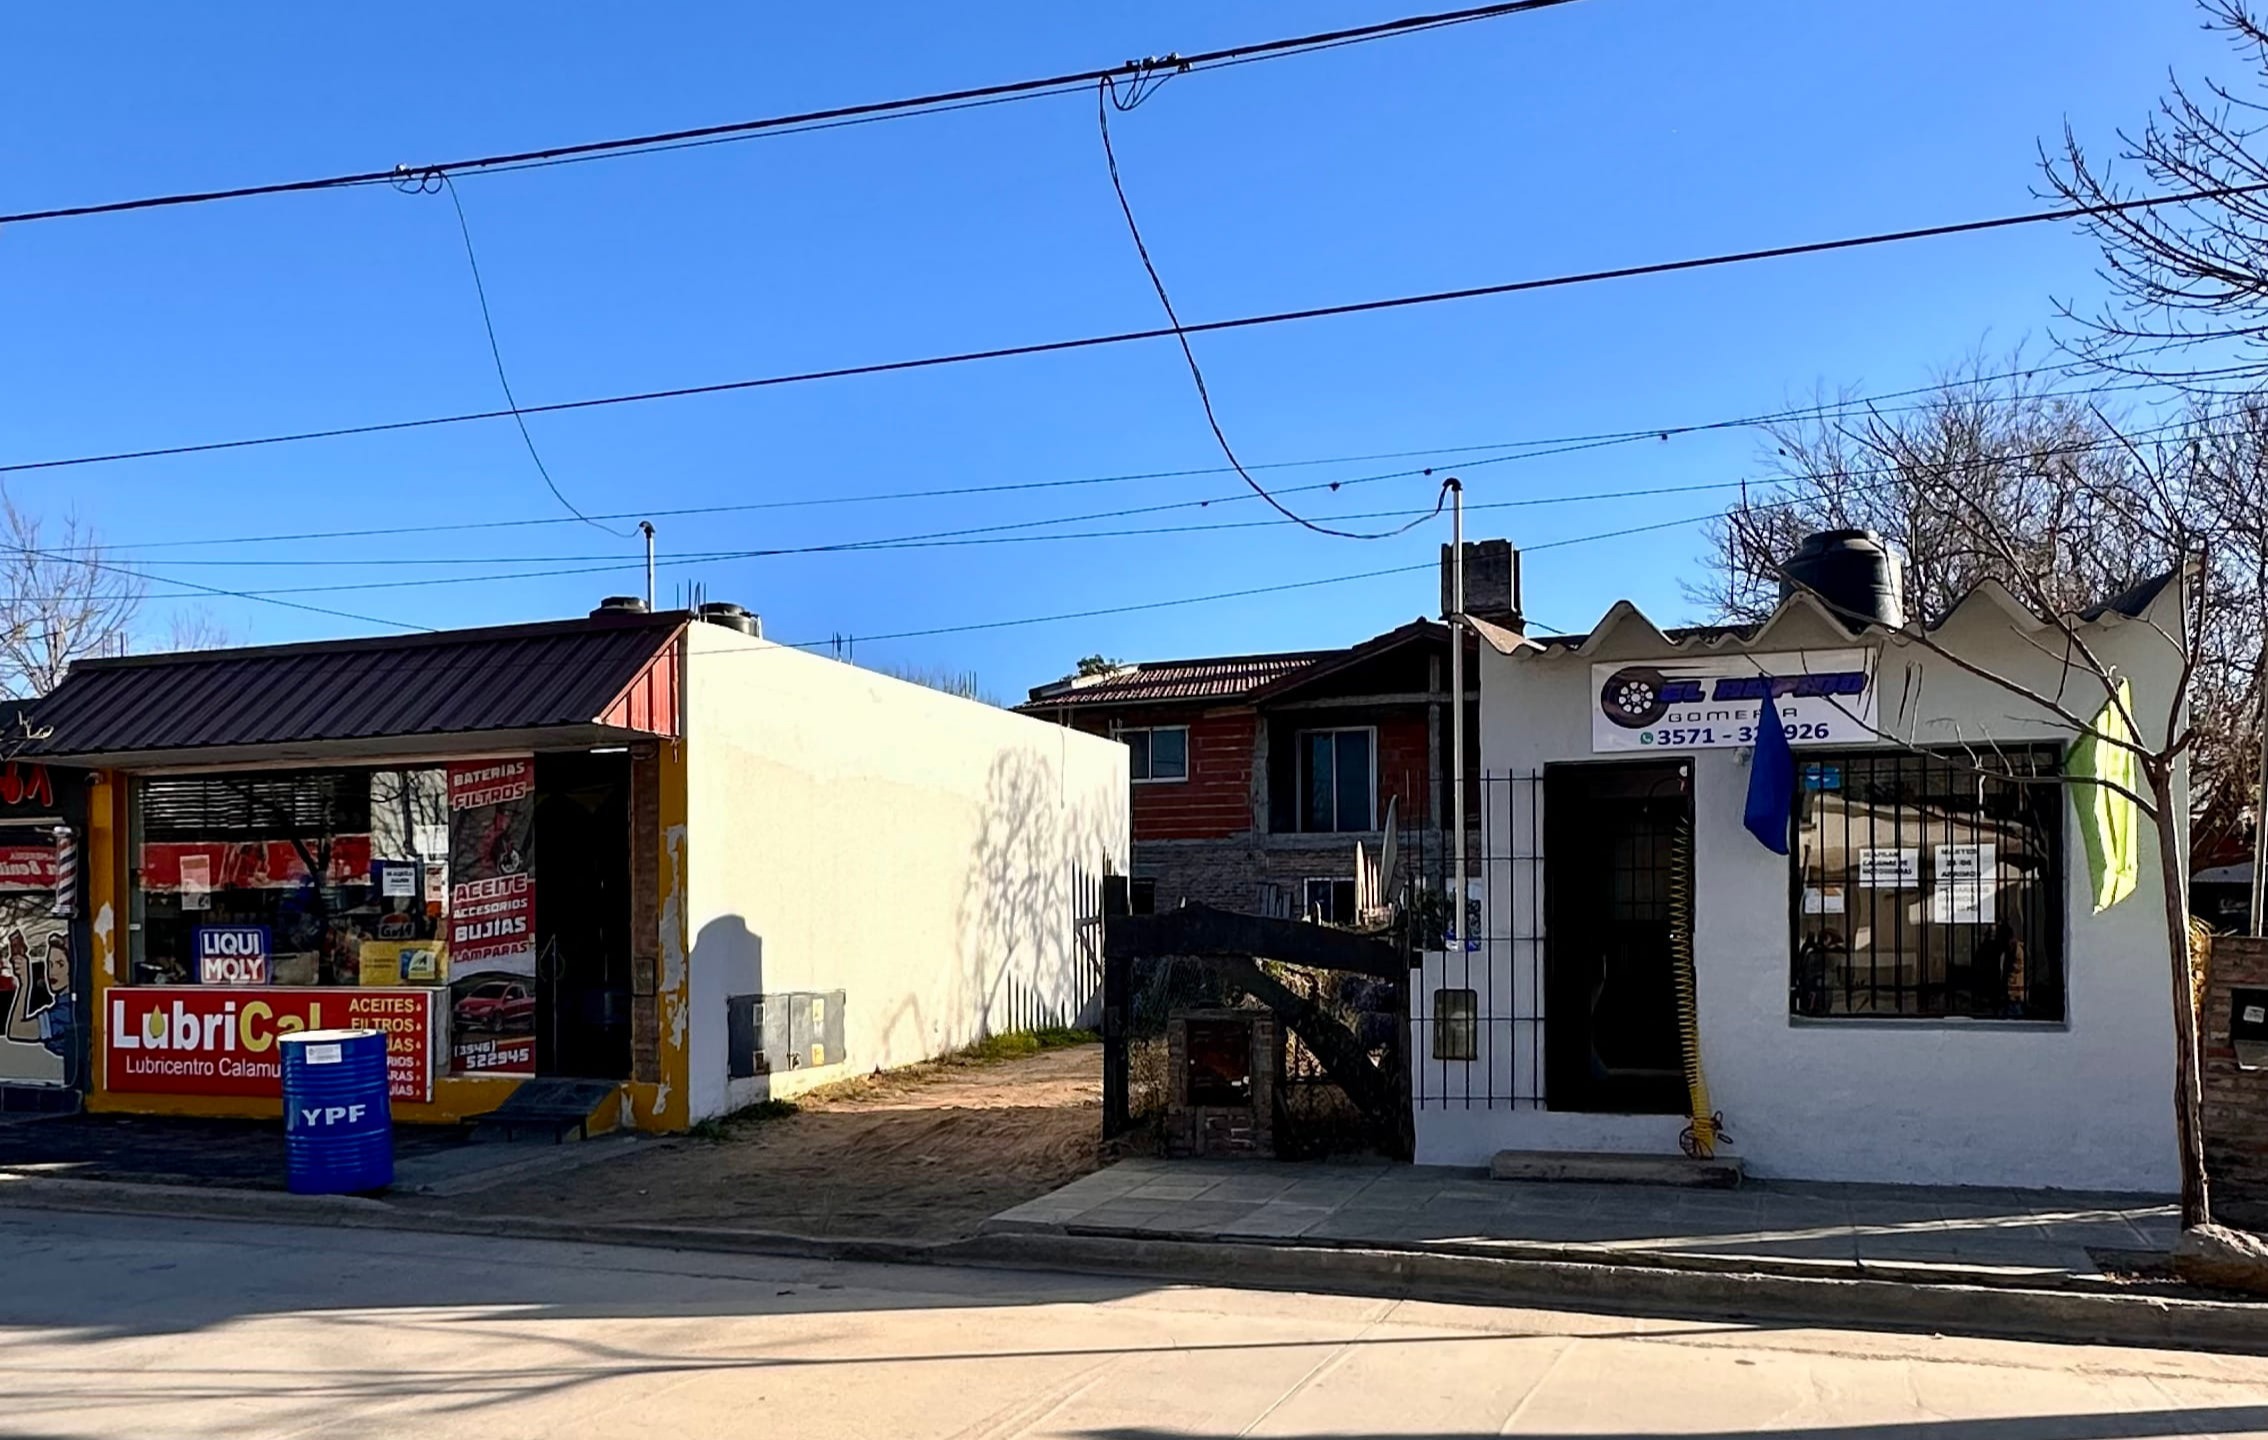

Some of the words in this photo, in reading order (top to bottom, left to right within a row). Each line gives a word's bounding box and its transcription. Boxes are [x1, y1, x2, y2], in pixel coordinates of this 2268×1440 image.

[1656, 680, 1706, 703] EL
[1668, 707, 1798, 723] GOMERA
[1657, 728, 1715, 746] 3571
[1738, 722, 1830, 743] 3926
[453, 782, 527, 812] FILTROS
[454, 873, 528, 903] ACEITE
[453, 898, 528, 918] ACCESORIOS
[455, 917, 527, 942] BUJÍAS
[203, 933, 260, 955] LIQUI
[205, 958, 262, 980] MOLY
[349, 998, 415, 1012] ACEITES
[113, 1000, 321, 1051] LubriCal
[126, 1056, 214, 1076] Lubricentro
[218, 1057, 281, 1077] Calamu
[466, 1048, 529, 1069] 522945
[301, 1104, 366, 1127] YPF
